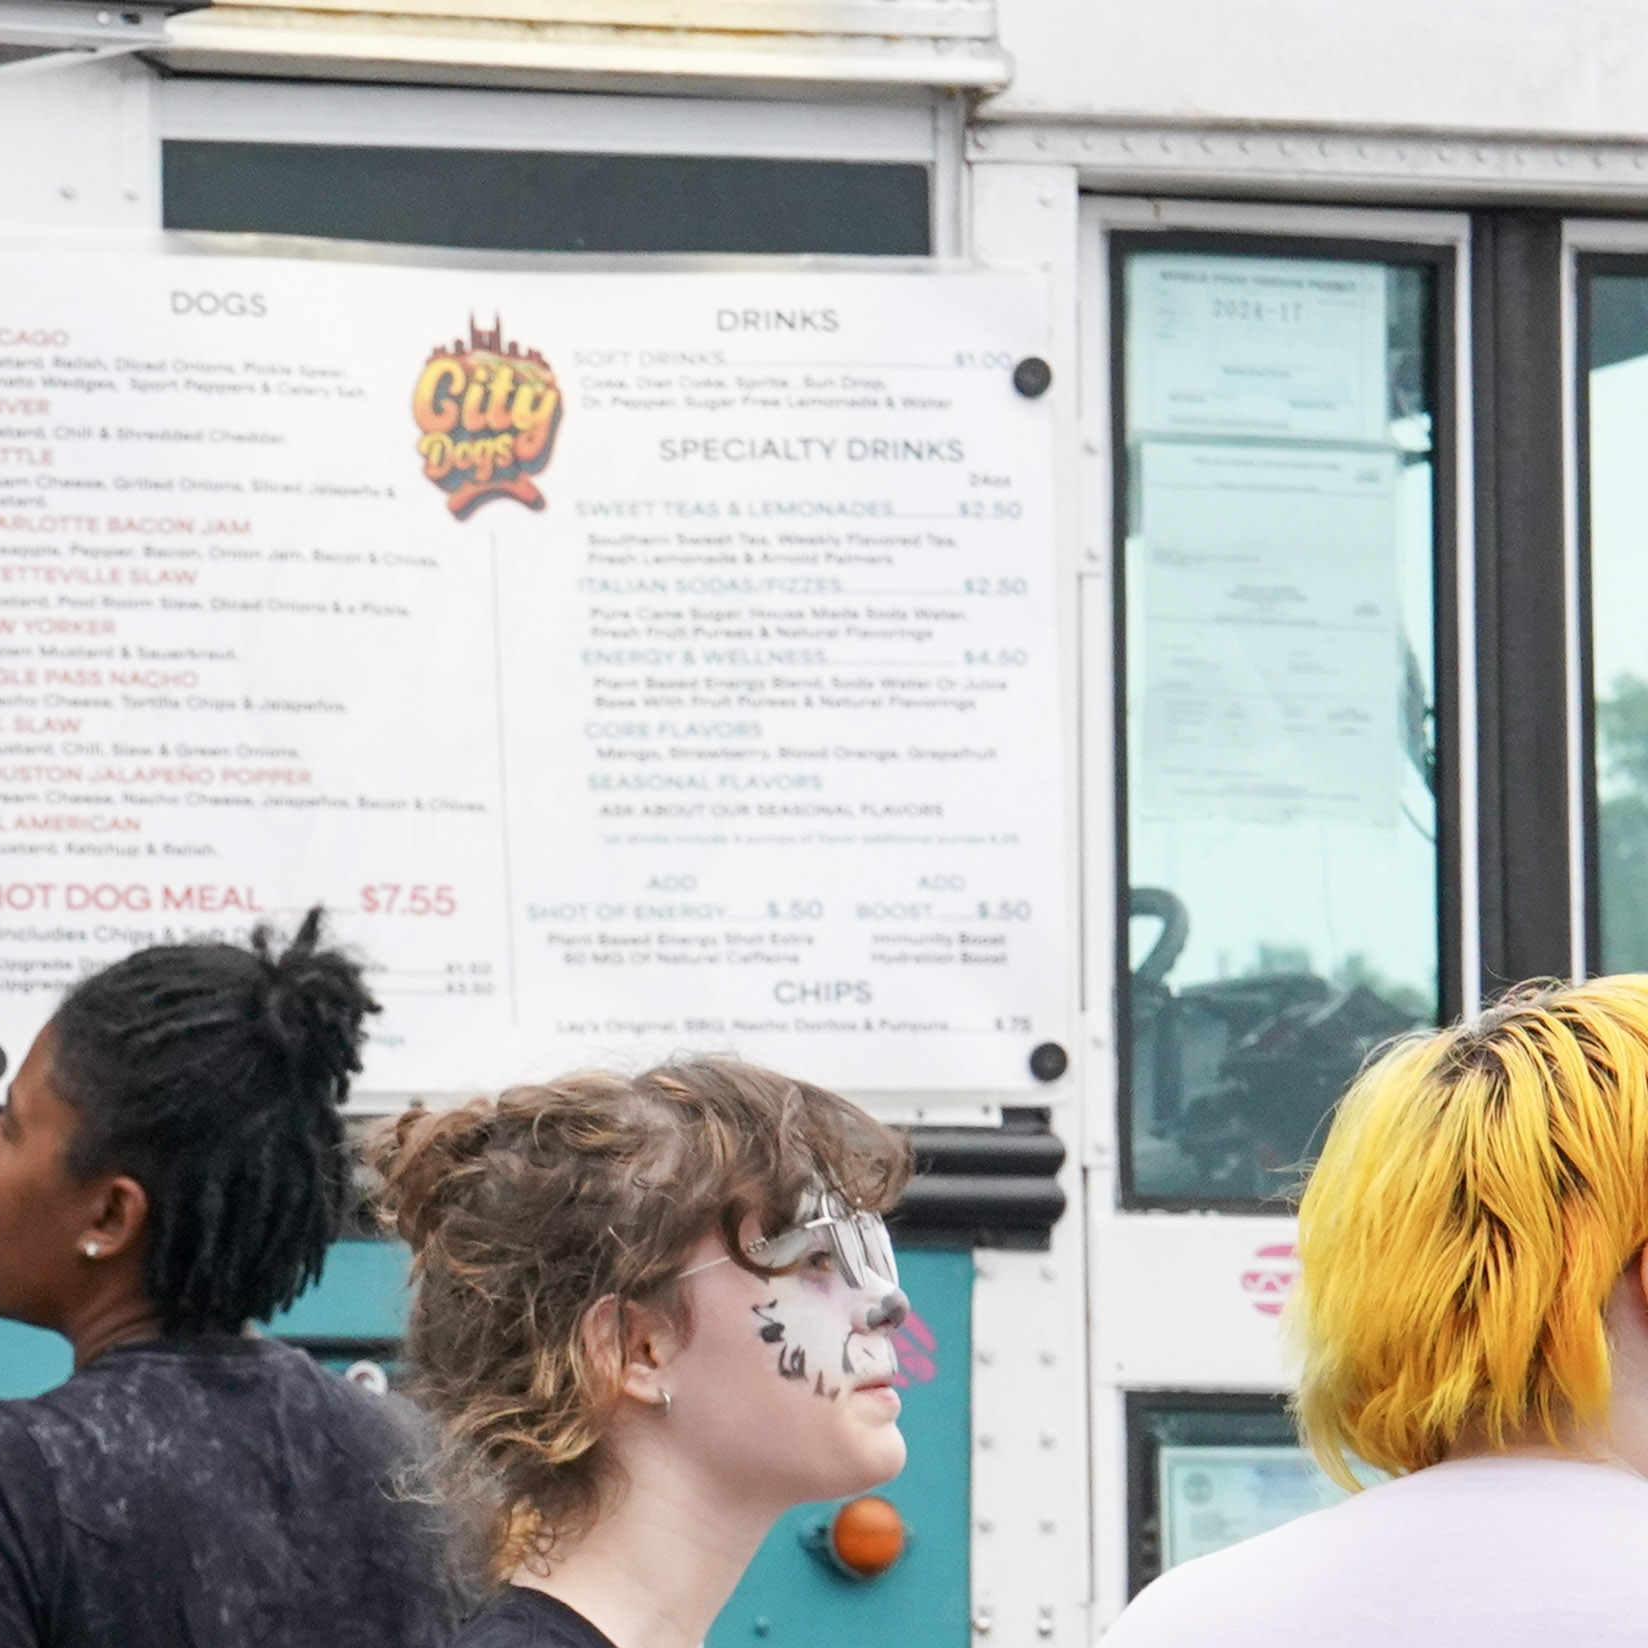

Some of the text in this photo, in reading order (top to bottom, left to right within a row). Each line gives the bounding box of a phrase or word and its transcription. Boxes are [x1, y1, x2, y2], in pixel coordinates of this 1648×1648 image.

[169, 290, 268, 317] DOGS
[716, 309, 840, 332] DRINKS
[414, 357, 560, 462] City
[417, 431, 515, 483] Dogs
[660, 437, 965, 462] SPECIALTY DRINKS
[106, 516, 195, 535] BACON
[201, 519, 251, 535] JAM
[128, 568, 198, 586] SLAW
[23, 617, 116, 636] YORKER
[44, 669, 104, 687] PASS
[109, 670, 199, 689] NACHO
[13, 717, 82, 734] SLAW
[88, 765, 215, 785] JALAPEÑO
[220, 767, 312, 787] POPPER
[13, 815, 142, 833] AMERICAN
[65, 883, 152, 912] DOG
[161, 885, 264, 912] MEAL
[360, 883, 457, 917] $7.55
[772, 979, 873, 1005] CHIPS
